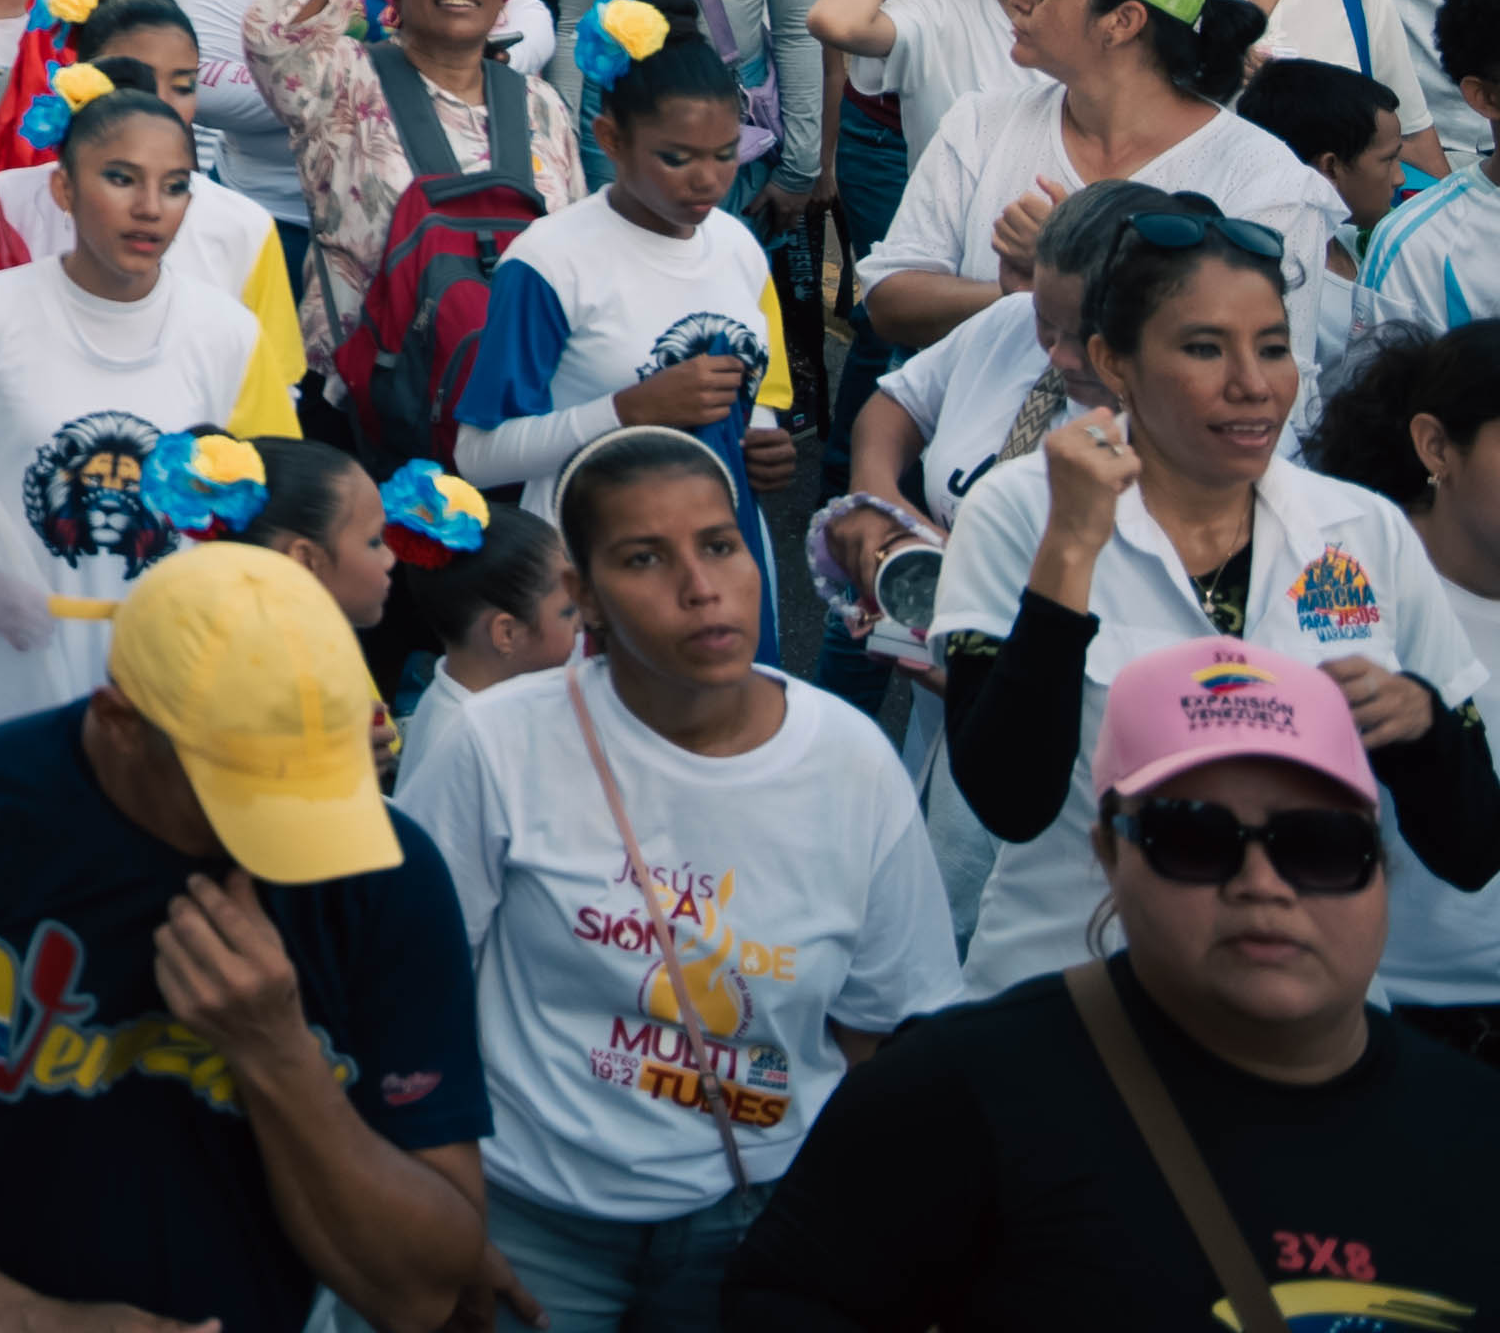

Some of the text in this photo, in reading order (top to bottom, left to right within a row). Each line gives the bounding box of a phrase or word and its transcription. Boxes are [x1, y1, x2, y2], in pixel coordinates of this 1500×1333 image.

[1297, 585, 1377, 611] MARCHA
[1300, 612, 1333, 631] PARA
[1180, 695, 1294, 718] EXPANSIÓN
[1185, 708, 1294, 728] VENEZUELA
[739, 940, 797, 982] DE
[610, 1016, 738, 1080] MULTI
[1272, 1230, 1377, 1283] 3X8
